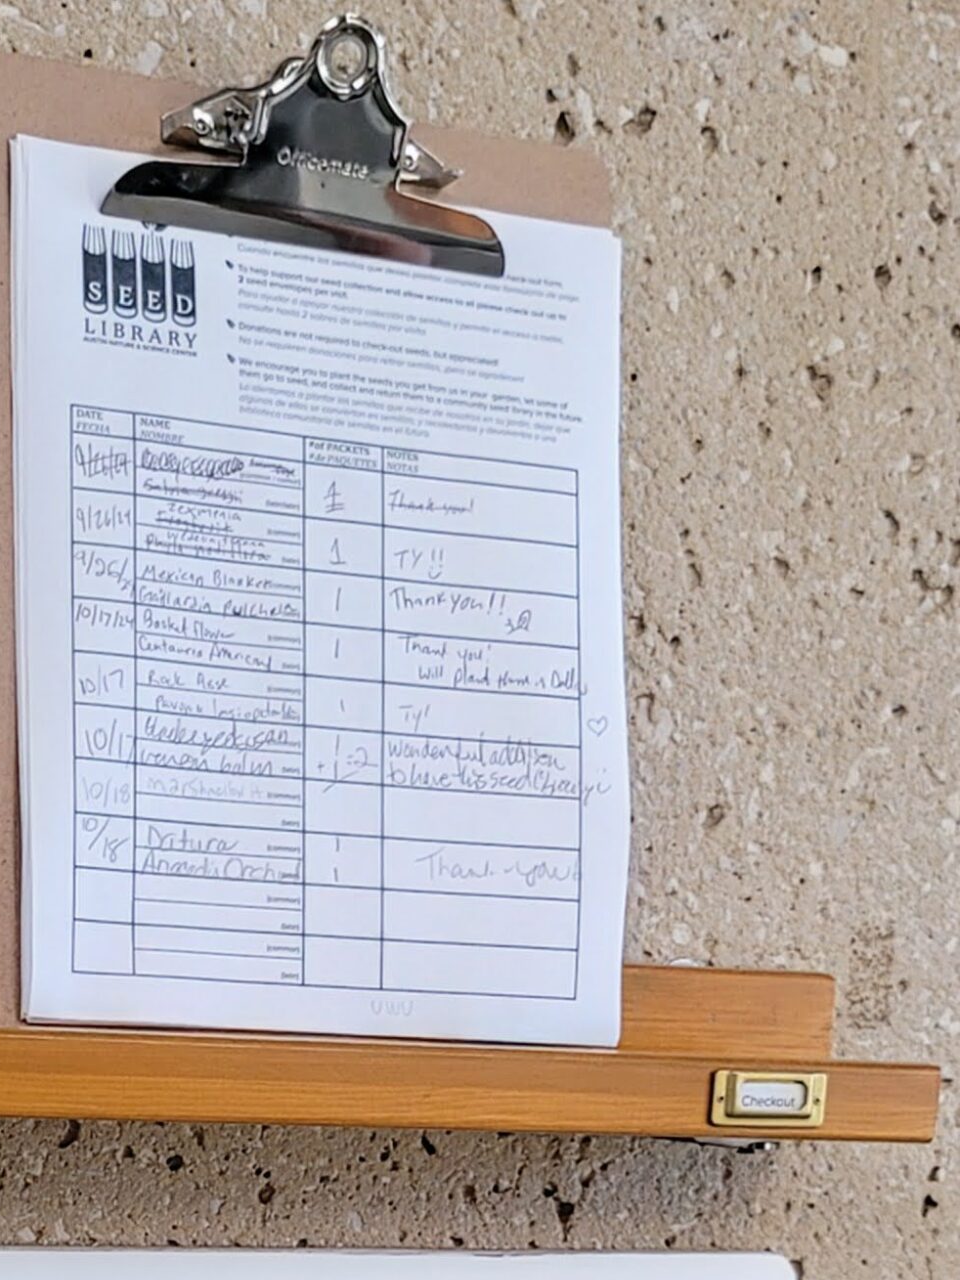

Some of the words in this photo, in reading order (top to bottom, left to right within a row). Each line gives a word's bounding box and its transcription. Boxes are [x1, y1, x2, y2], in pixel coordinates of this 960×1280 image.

[277, 145, 368, 179] Officemate
[88, 281, 193, 314] SEED
[85, 317, 197, 349] LIBRARY
[76, 408, 102, 421] DATE
[76, 421, 110, 435] FECHA
[140, 416, 170, 430] NAME
[140, 428, 183, 443] NOMBRE
[326, 440, 369, 456] PACKETS
[387, 448, 418, 462] NOTES
[326, 452, 377, 469] PAQUETES
[387, 460, 418, 473] NOTAS
[140, 564, 203, 586] Mexican
[213, 569, 270, 591] Blanket
[389, 584, 444, 615] Thank
[741, 1095, 795, 1108] Checkout
